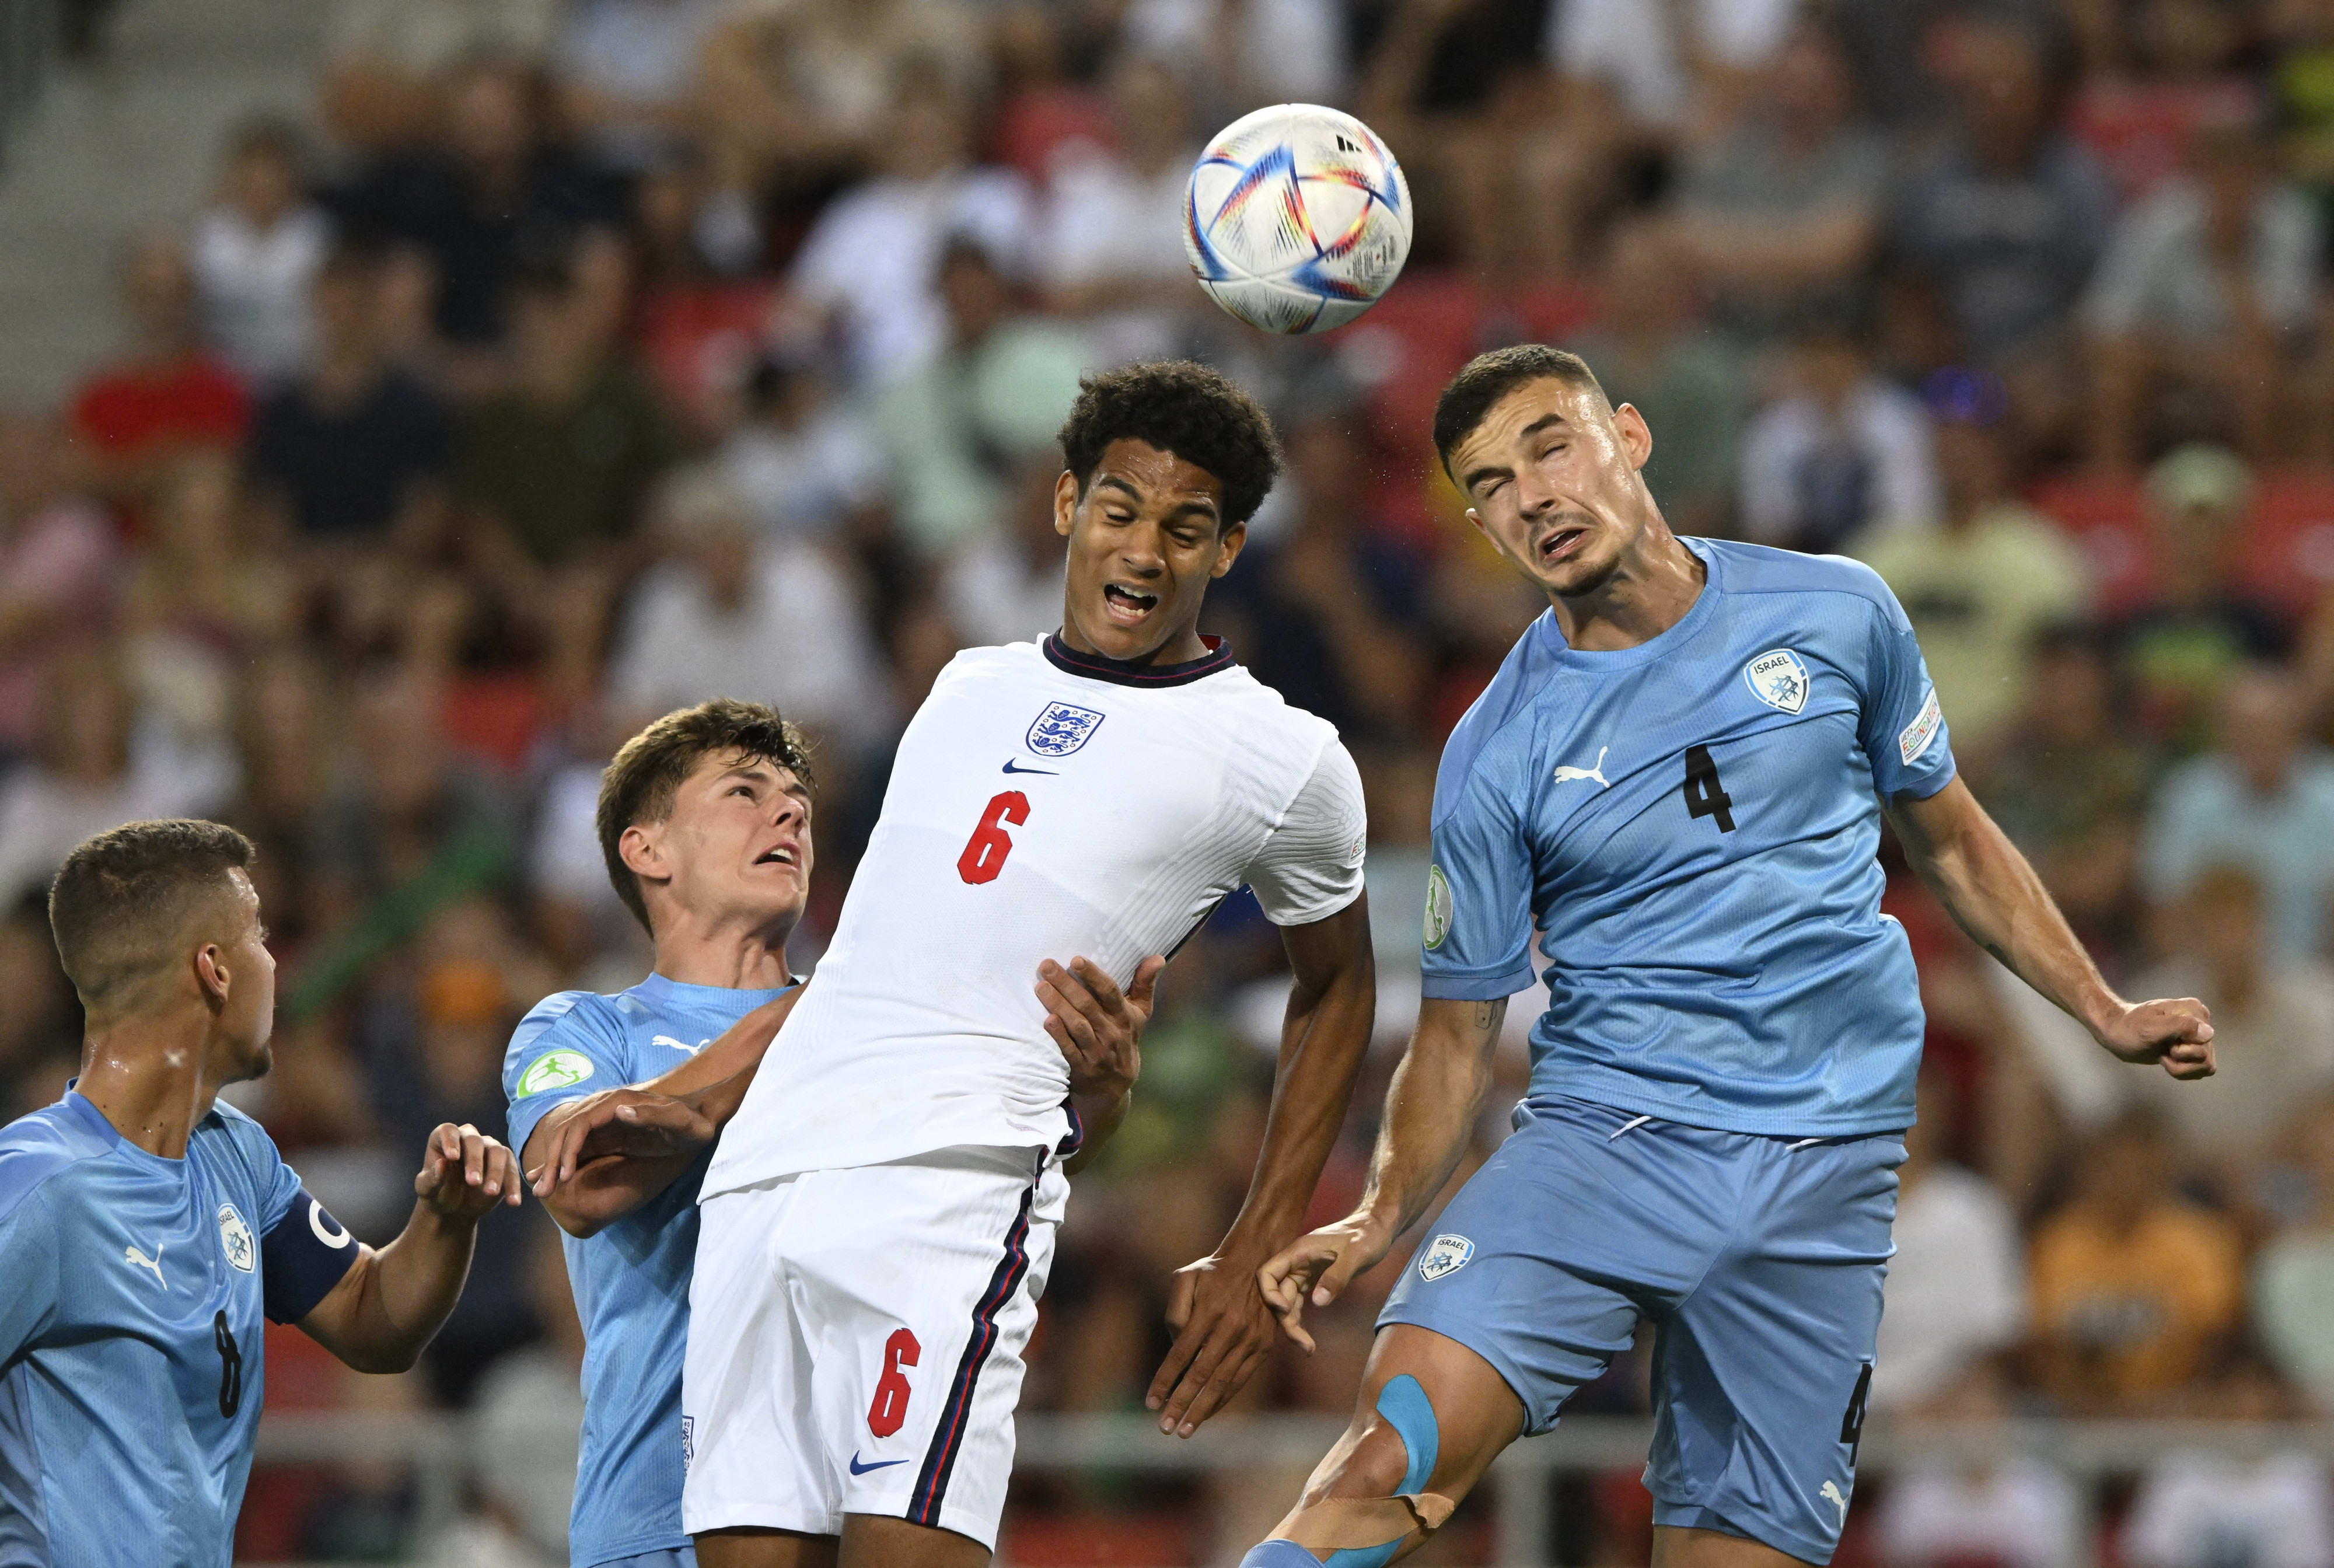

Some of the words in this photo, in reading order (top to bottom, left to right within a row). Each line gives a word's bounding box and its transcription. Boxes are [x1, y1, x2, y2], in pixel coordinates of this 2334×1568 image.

[1754, 656, 1790, 674] ISRAEL
[1901, 728, 1913, 742] UEFA
[1683, 743, 1737, 834] 4
[957, 791, 1030, 885] 6
[219, 1210, 235, 1225] SRAEL
[1437, 1239, 1465, 1250] ISRAEL
[214, 1309, 242, 1419] 8
[867, 1328, 921, 1438] 6
[1839, 1363, 1872, 1467] 4
